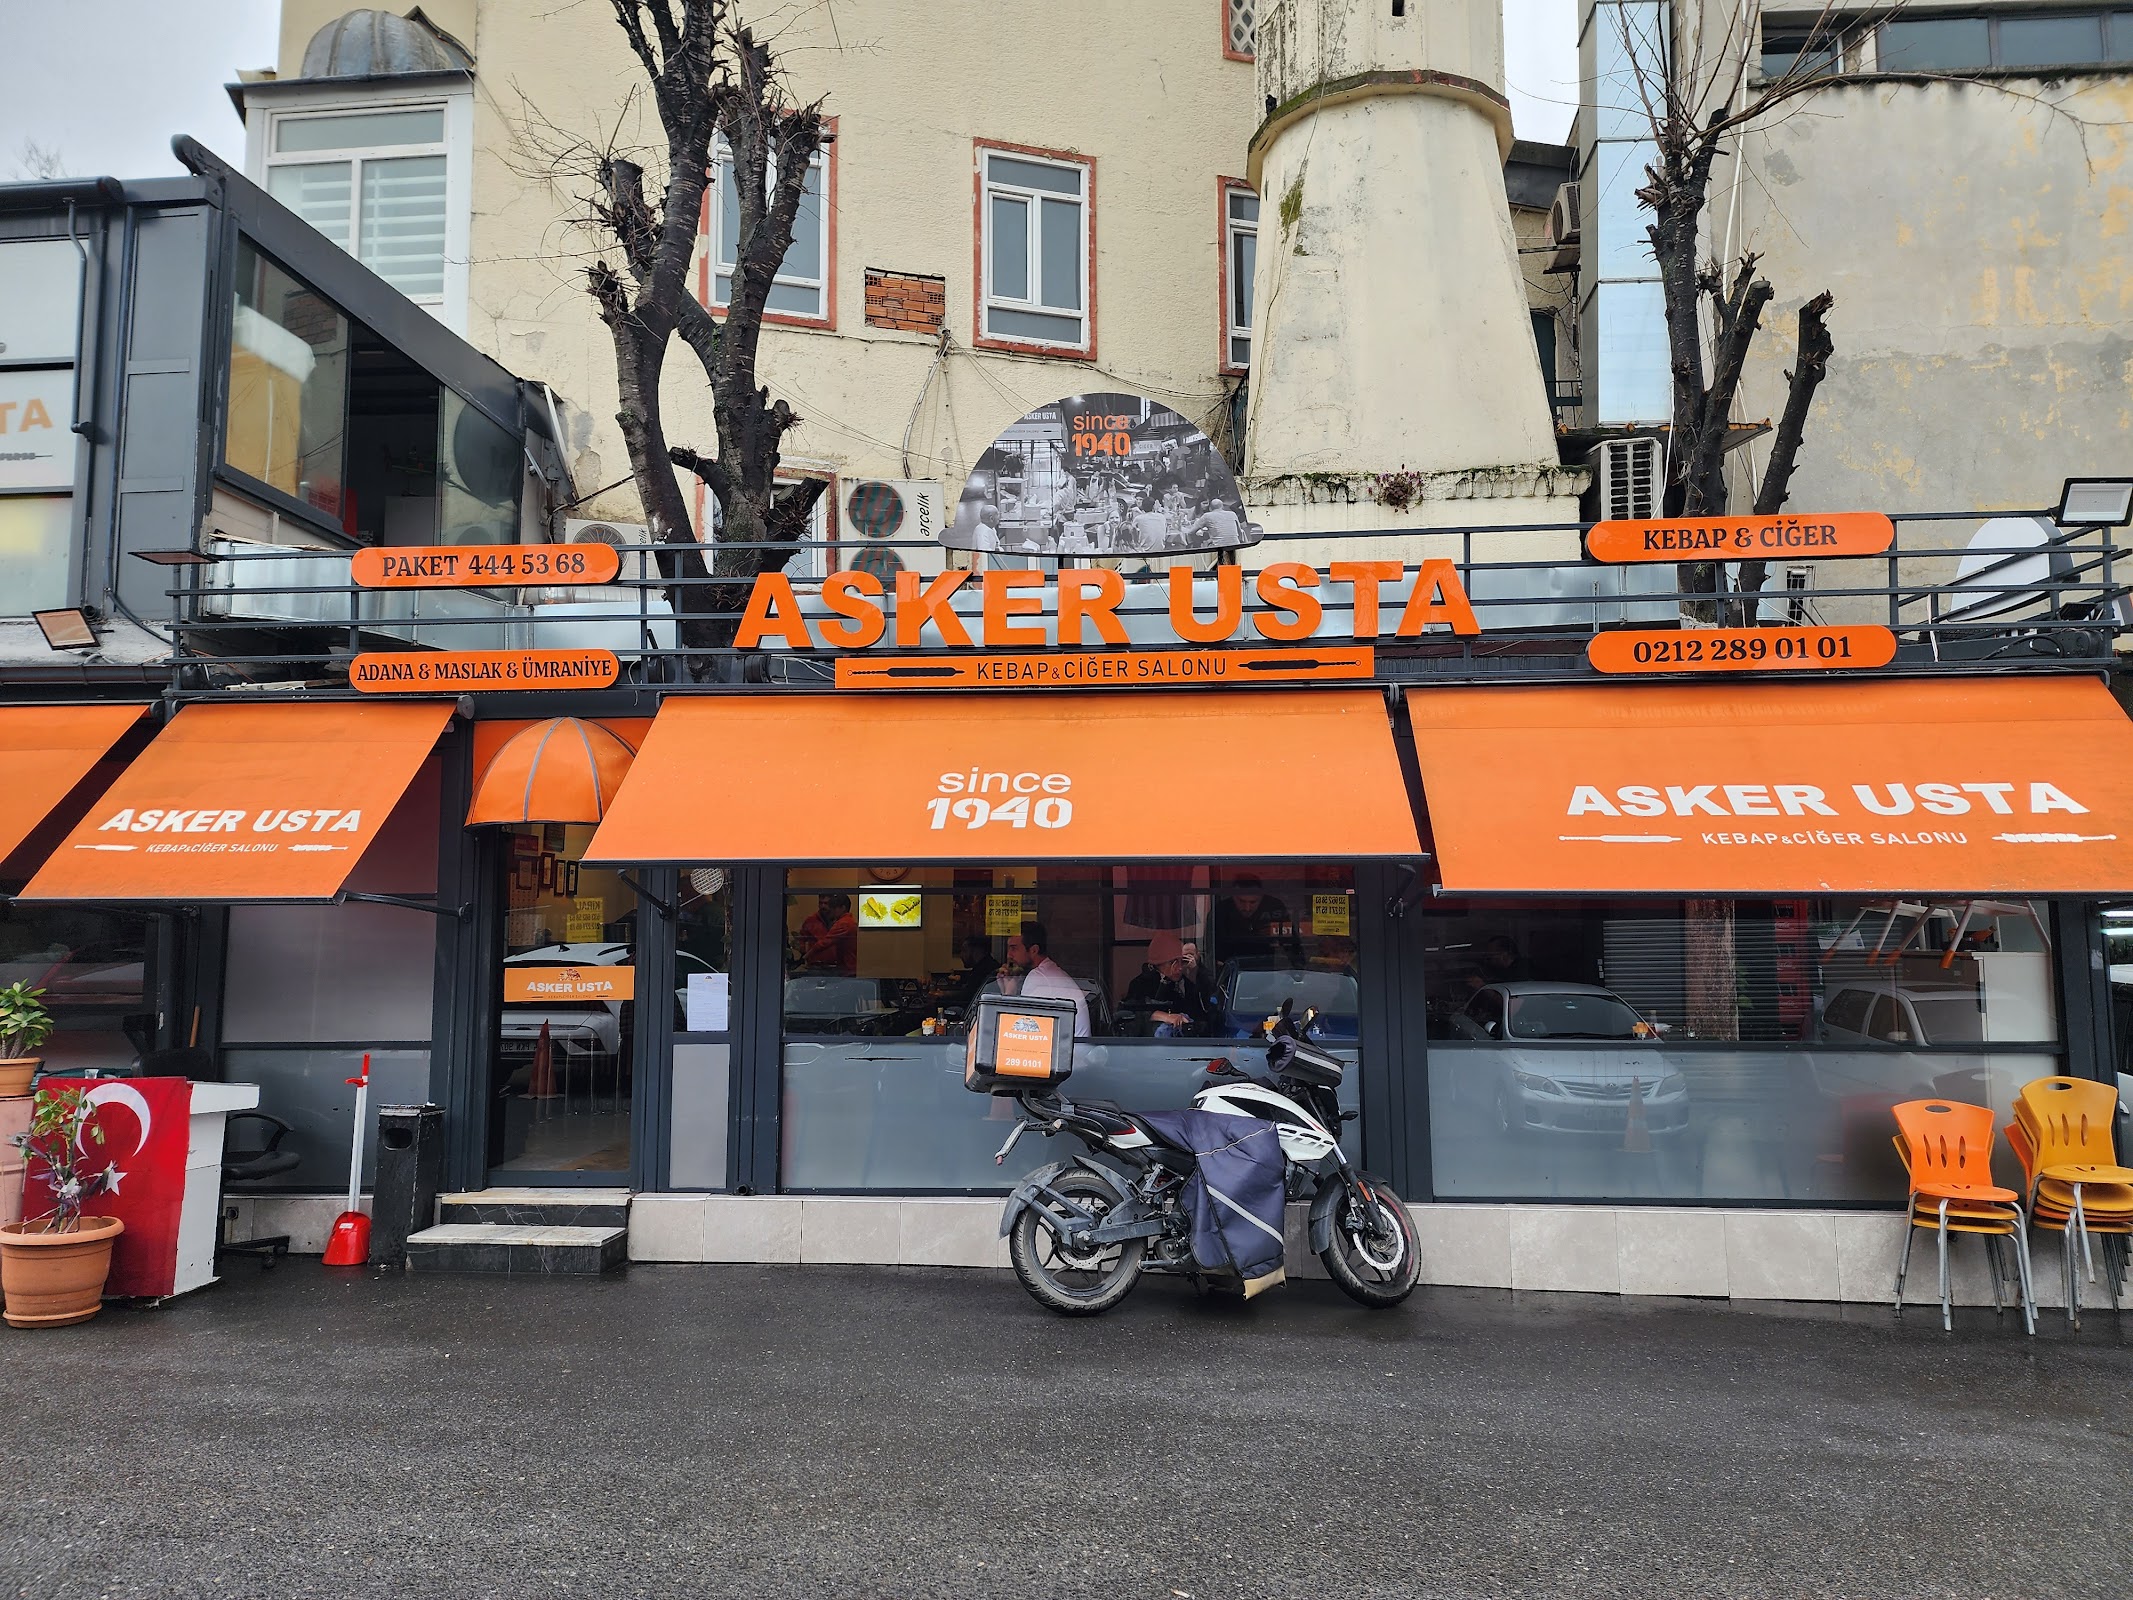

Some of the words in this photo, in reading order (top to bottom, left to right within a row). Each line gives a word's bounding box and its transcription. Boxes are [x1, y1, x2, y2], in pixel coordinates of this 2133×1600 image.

[1042, 411, 1057, 420] USTA
[1073, 410, 1129, 431] since
[1072, 432, 1131, 457] 1940
[1643, 528, 1727, 550] KEBAP
[1734, 527, 1754, 548] &
[1759, 520, 1838, 546] CİĞER
[383, 555, 459, 577] PAKET
[468, 554, 516, 575] 444
[522, 554, 550, 574] 53
[555, 553, 585, 574] 68
[732, 568, 1131, 648] ASKER
[1170, 559, 1483, 643] USTA
[1633, 640, 1704, 663] 0212
[1710, 637, 1767, 661] 289
[1775, 637, 1809, 659] 01
[1817, 636, 1852, 658] 01
[357, 662, 415, 681] ADANA
[418, 663, 431, 679] &
[434, 661, 502, 680] MASLAK
[506, 661, 519, 678] &
[522, 655, 612, 678] ÜMRANİYE
[977, 654, 1130, 681] KEBAP&CİĞER
[1138, 657, 1228, 679] SALONU
[937, 766, 1072, 794] since
[1566, 785, 1839, 817] ASKER
[1852, 782, 2091, 815] USTA
[98, 809, 247, 833] ASKER
[252, 809, 362, 832] USTA
[927, 796, 1073, 830] 1940
[227, 843, 280, 853] SALONU
[1700, 828, 1866, 847] KEBAP&CİĞER
[1871, 832, 1969, 846] SALONU
[527, 982, 573, 993] ASKER
[577, 981, 613, 992] USTA
[1003, 1031, 1028, 1040] ASKER
[1005, 1057, 1020, 1066] 289
[1022, 1059, 1042, 1068] 0101
